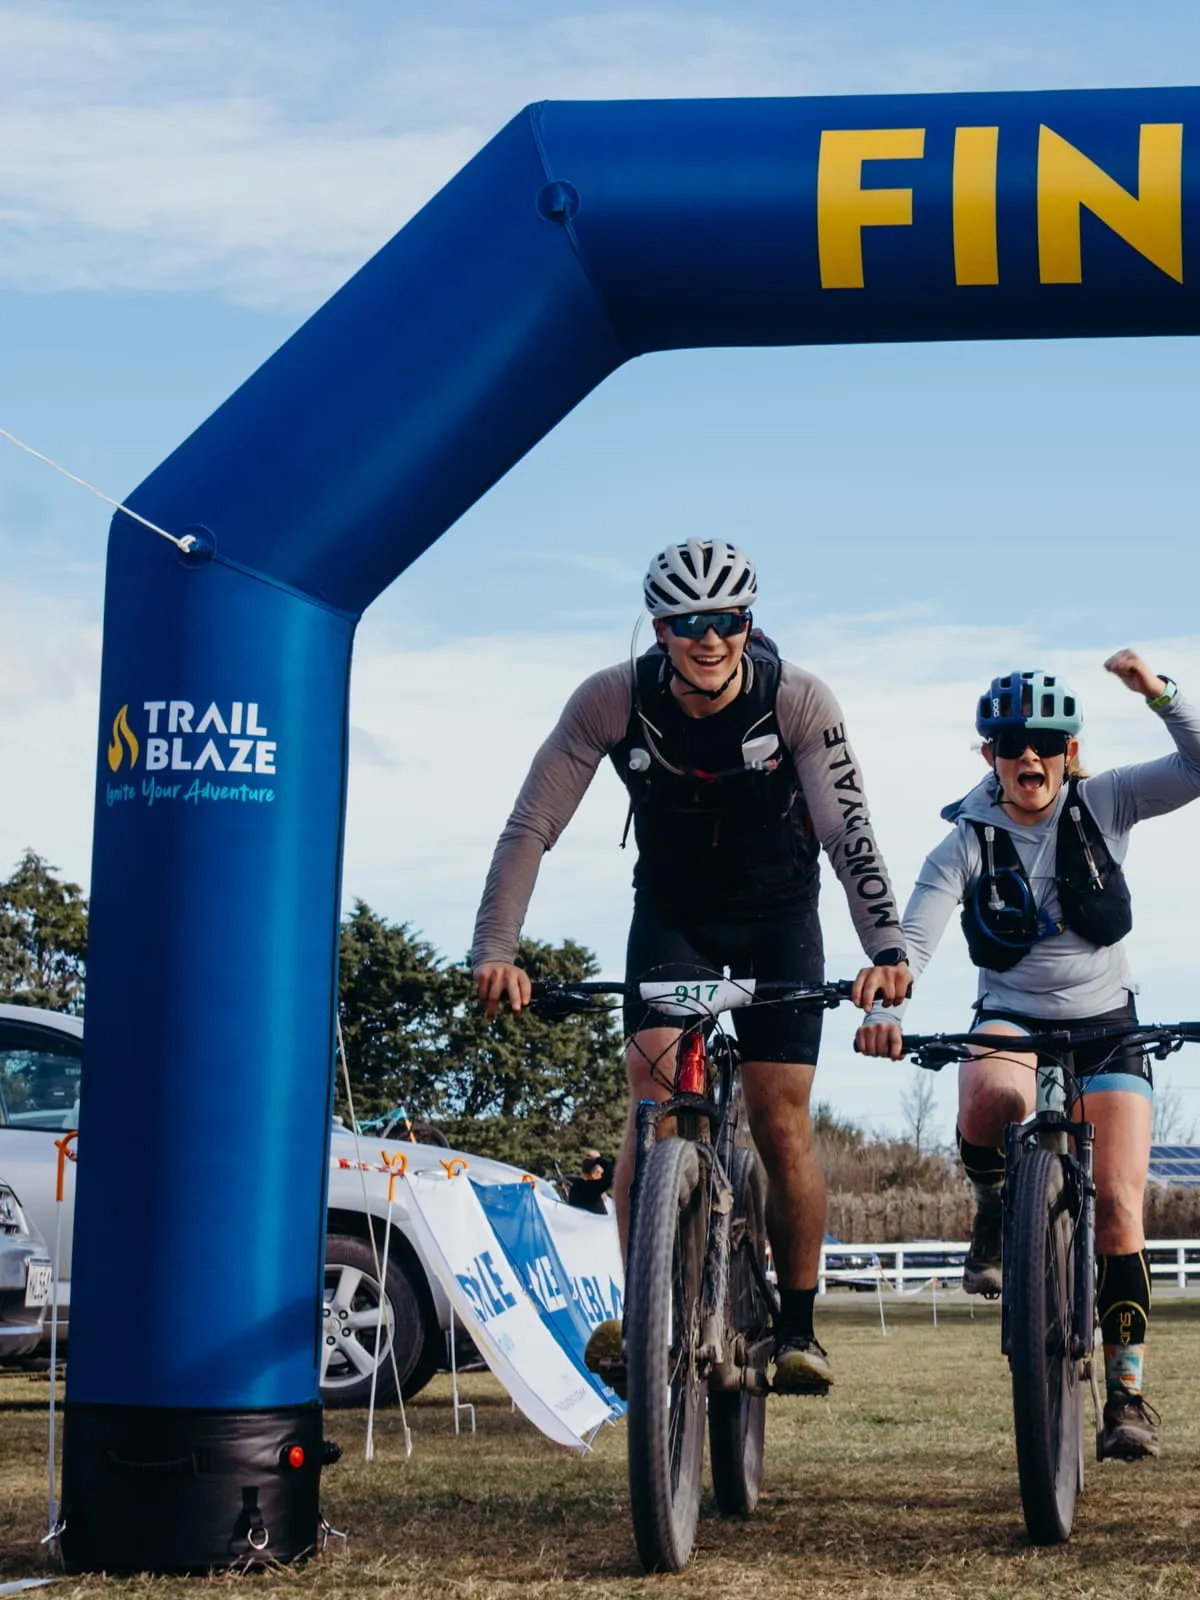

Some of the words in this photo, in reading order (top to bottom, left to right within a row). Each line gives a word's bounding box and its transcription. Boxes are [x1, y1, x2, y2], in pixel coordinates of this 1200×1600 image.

[143, 700, 267, 737] TRAIL
[146, 737, 277, 775] BLAZE
[106, 781, 136, 807] Ignite
[142, 776, 181, 807] Your
[183, 778, 276, 806] Adventure
[675, 984, 719, 1003] 917
